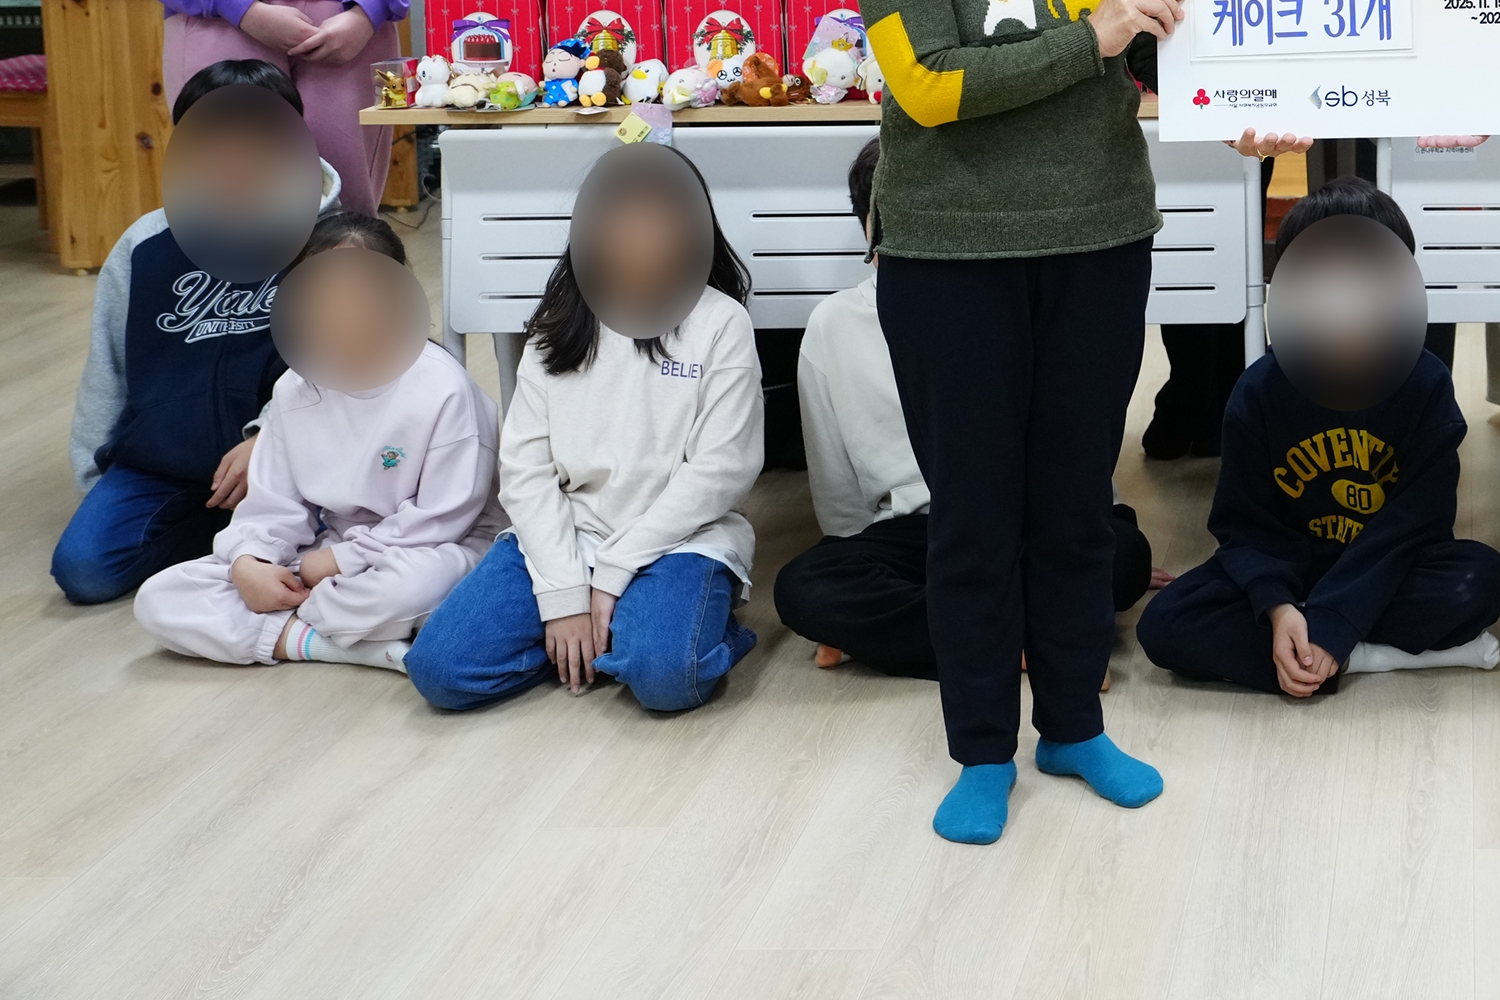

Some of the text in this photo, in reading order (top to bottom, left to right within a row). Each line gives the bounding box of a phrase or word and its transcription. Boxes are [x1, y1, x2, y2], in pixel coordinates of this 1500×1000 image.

[1213, 88, 1278, 103] 사랑의열매
[1325, 85, 1391, 107] sb 성북
[156, 270, 279, 333] Yale
[1346, 484, 1372, 511] 80
